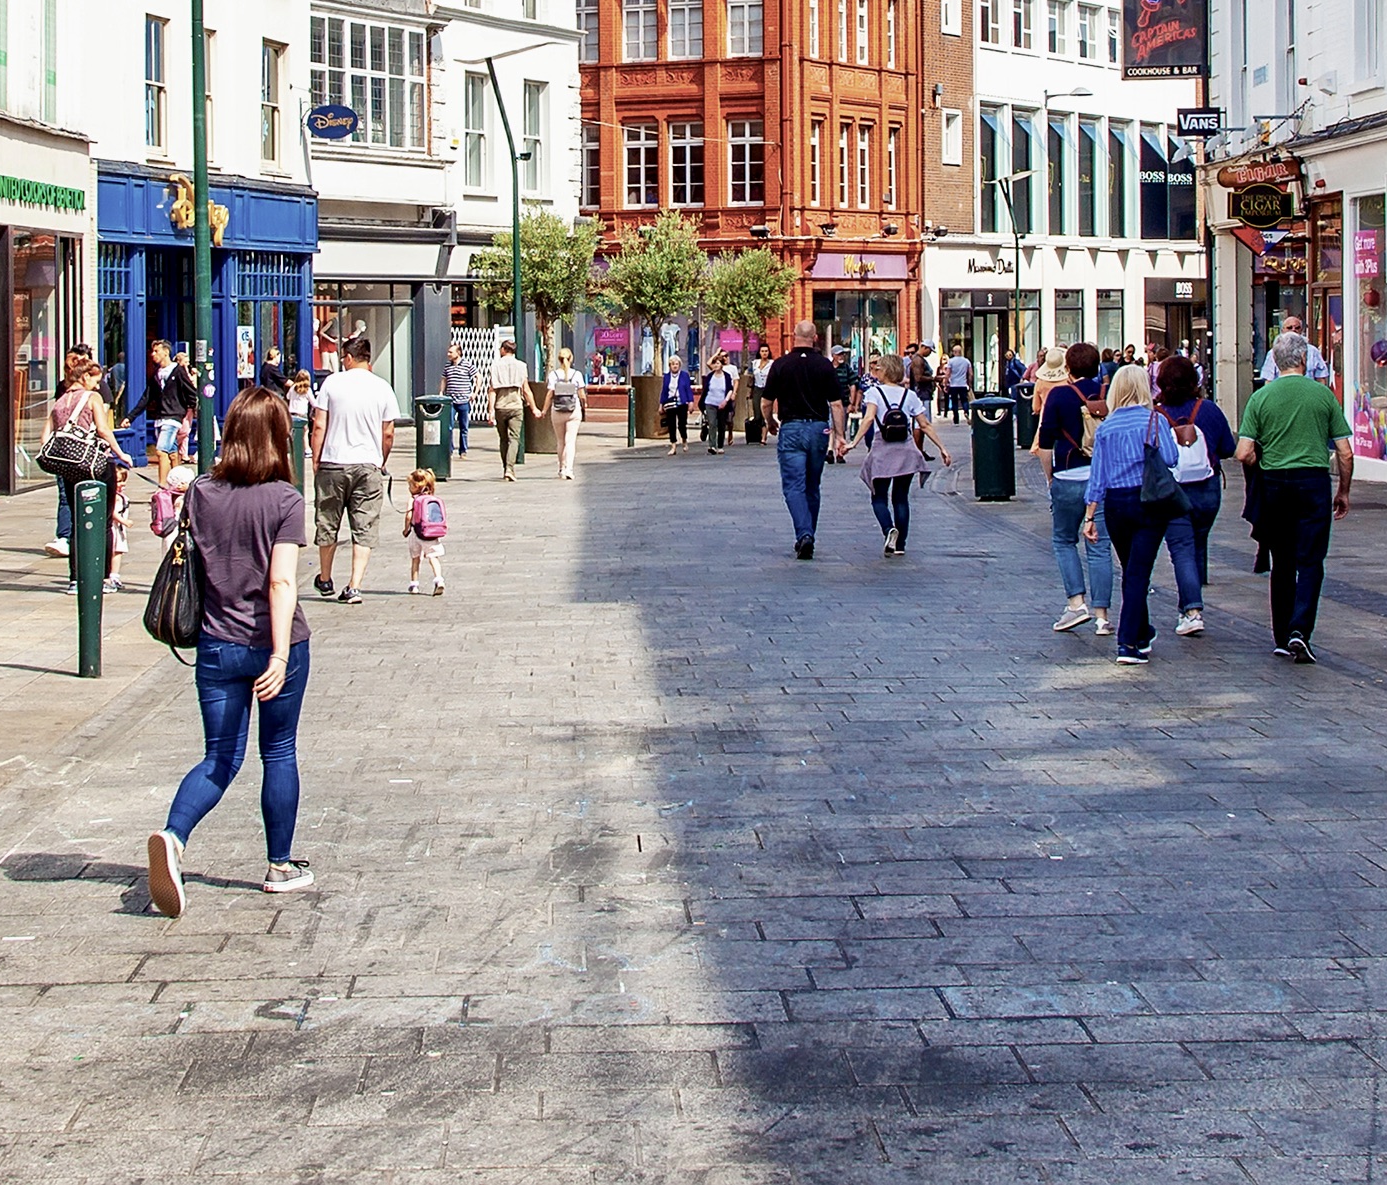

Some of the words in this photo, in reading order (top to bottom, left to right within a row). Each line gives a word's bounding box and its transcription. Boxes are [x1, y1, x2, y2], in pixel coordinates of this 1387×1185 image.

[1131, 20, 1180, 48] CAPTAIN
[1137, 28, 1197, 61] AMERICAS
[1127, 67, 1171, 76] COOKHOUSE
[1173, 67, 1180, 75] &
[1182, 66, 1198, 75] BAR
[311, 112, 354, 130] Disney
[1178, 114, 1218, 130] VANS
[1140, 171, 1165, 180] BOSS
[1168, 173, 1193, 182] BOSS
[21, 178, 47, 204] COLORS
[47, 183, 56, 205] OF
[56, 186, 85, 210] BENETTON
[1240, 200, 1281, 211] CIGAR
[1354, 236, 1362, 251] Get
[1363, 238, 1375, 249] more
[1176, 282, 1193, 294] BOSS
